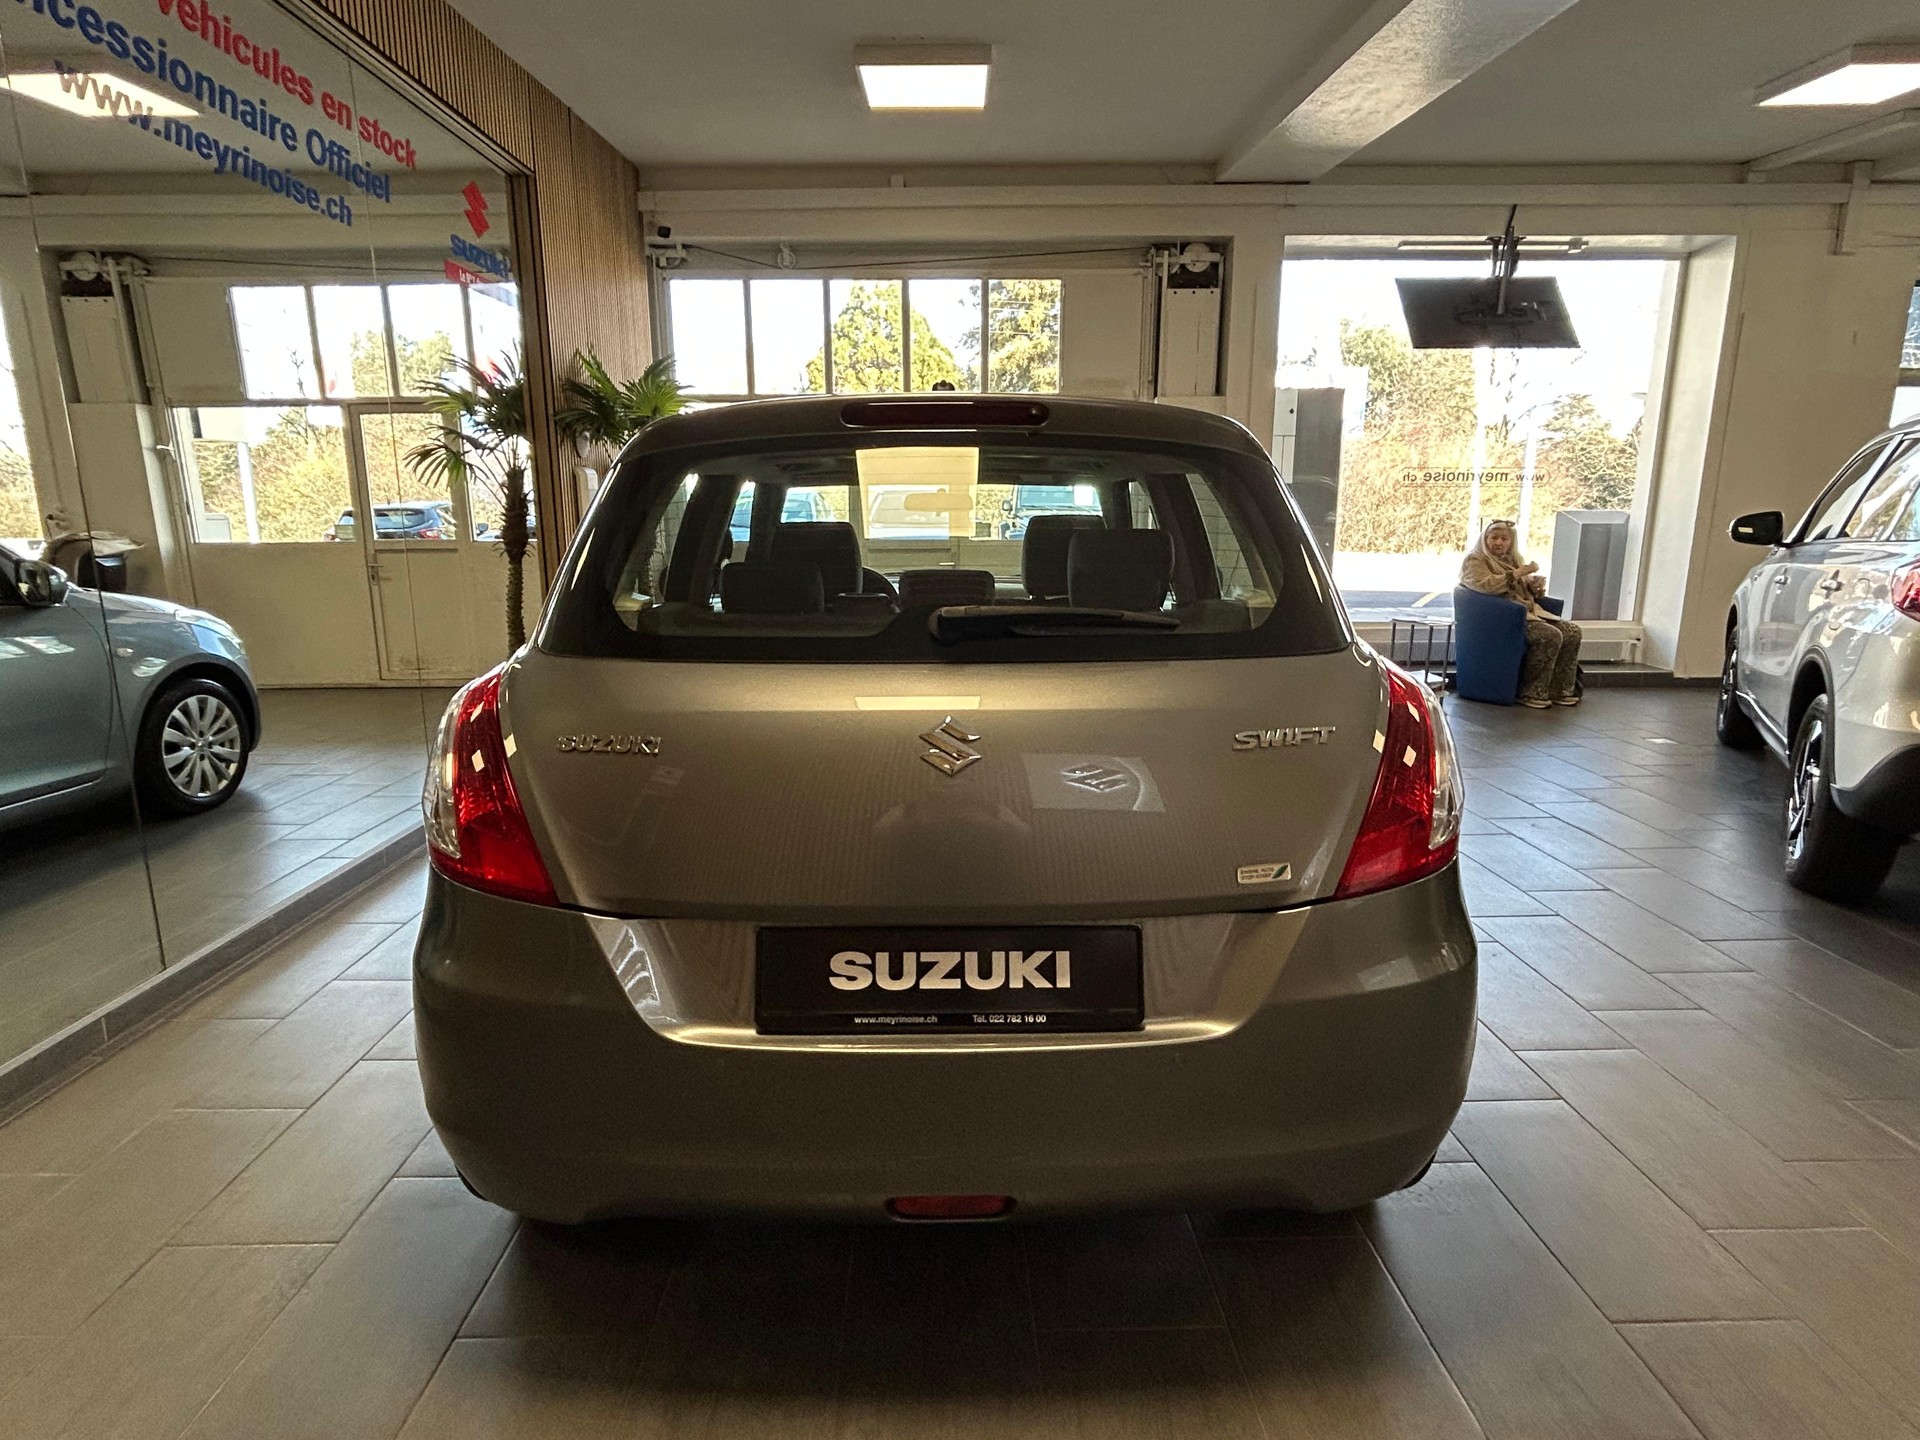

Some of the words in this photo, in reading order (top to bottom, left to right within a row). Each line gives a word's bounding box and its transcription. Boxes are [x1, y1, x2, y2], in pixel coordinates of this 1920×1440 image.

[53, 59, 352, 227] www.meyrinoise.ch
[322, 91, 352, 131] en
[358, 115, 417, 170] stock
[306, 128, 391, 203] Officiel
[557, 734, 662, 755] SUZUKI
[1232, 726, 1336, 751] SWIFT
[829, 951, 1070, 990] SUZUKI
[854, 1015, 938, 1025] www.meyrinoise.ch
[989, 1015, 1005, 1023] 022
[1006, 1015, 1022, 1023] 782
[1024, 1015, 1034, 1023] 16
[1036, 1015, 1047, 1023] 00
